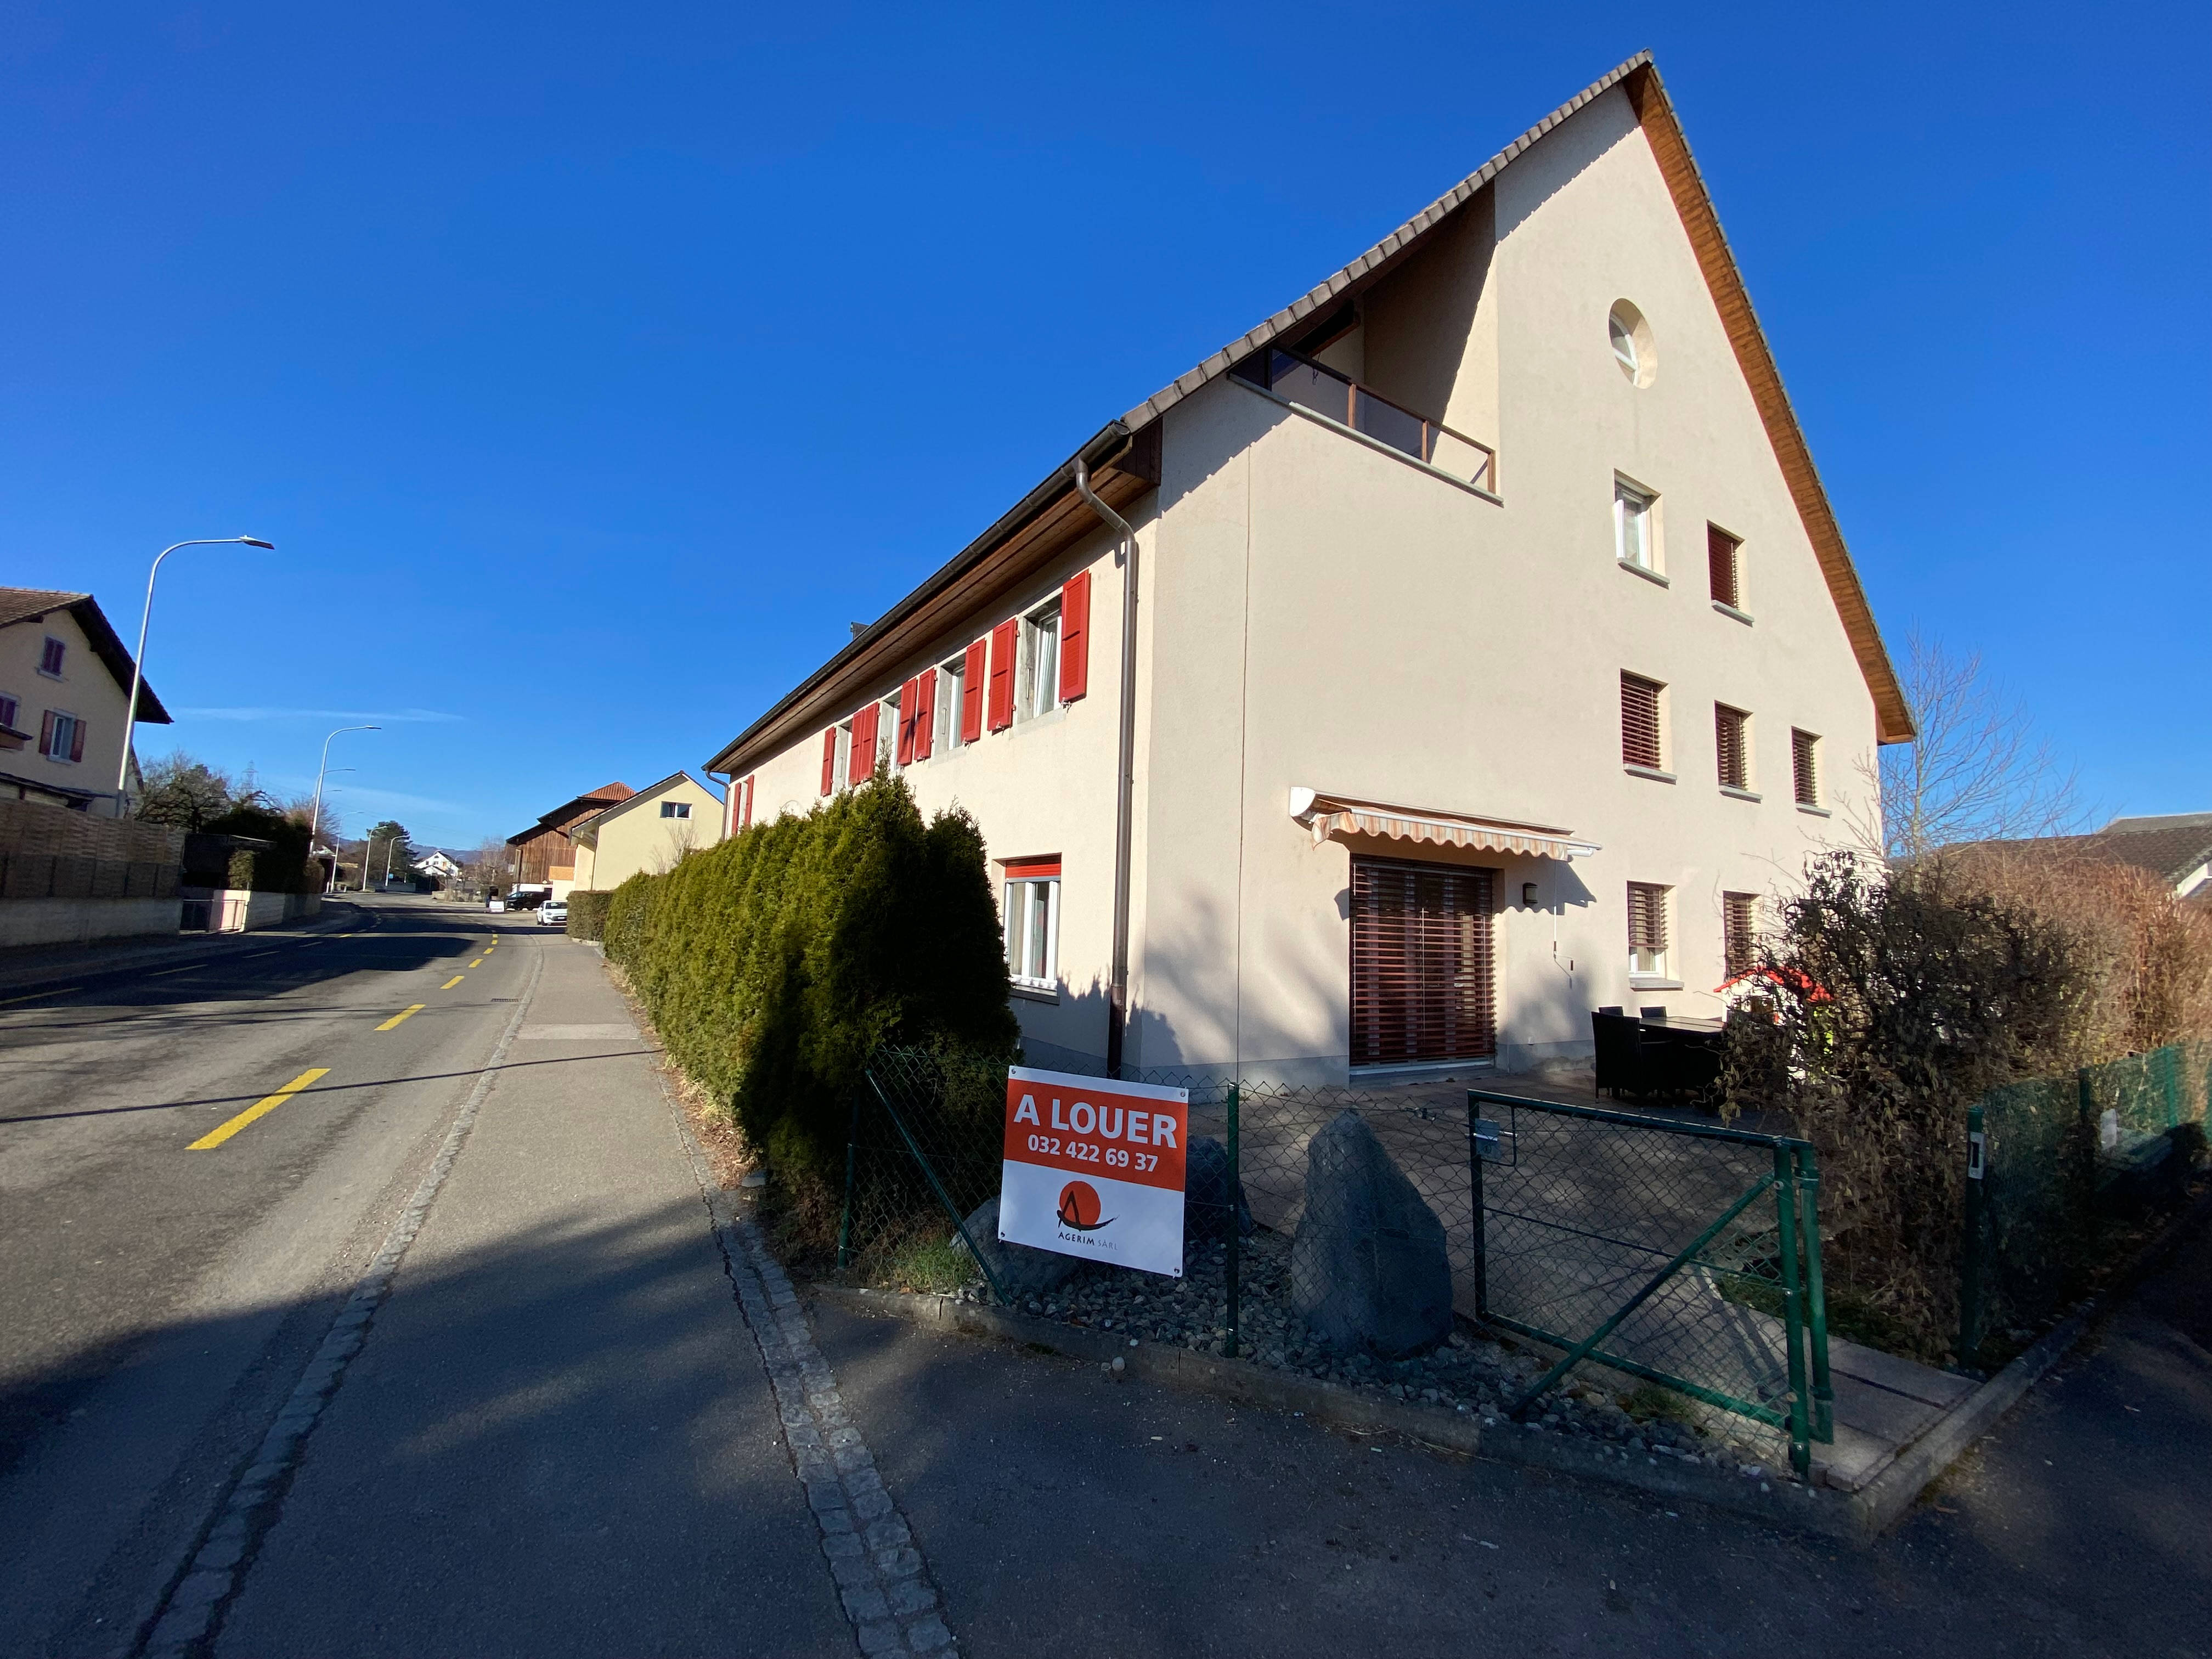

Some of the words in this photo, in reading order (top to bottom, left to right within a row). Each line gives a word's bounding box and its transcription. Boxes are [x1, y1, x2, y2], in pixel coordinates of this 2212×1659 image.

[1013, 1094, 1040, 1126] A
[1051, 1099, 1177, 1149] LOUER
[1028, 1134, 1060, 1155] 032
[1065, 1141, 1099, 1163] 422
[1105, 1148, 1129, 1168] 69
[1134, 1152, 1158, 1172] 37
[1058, 1231, 1095, 1246] AGERIM
